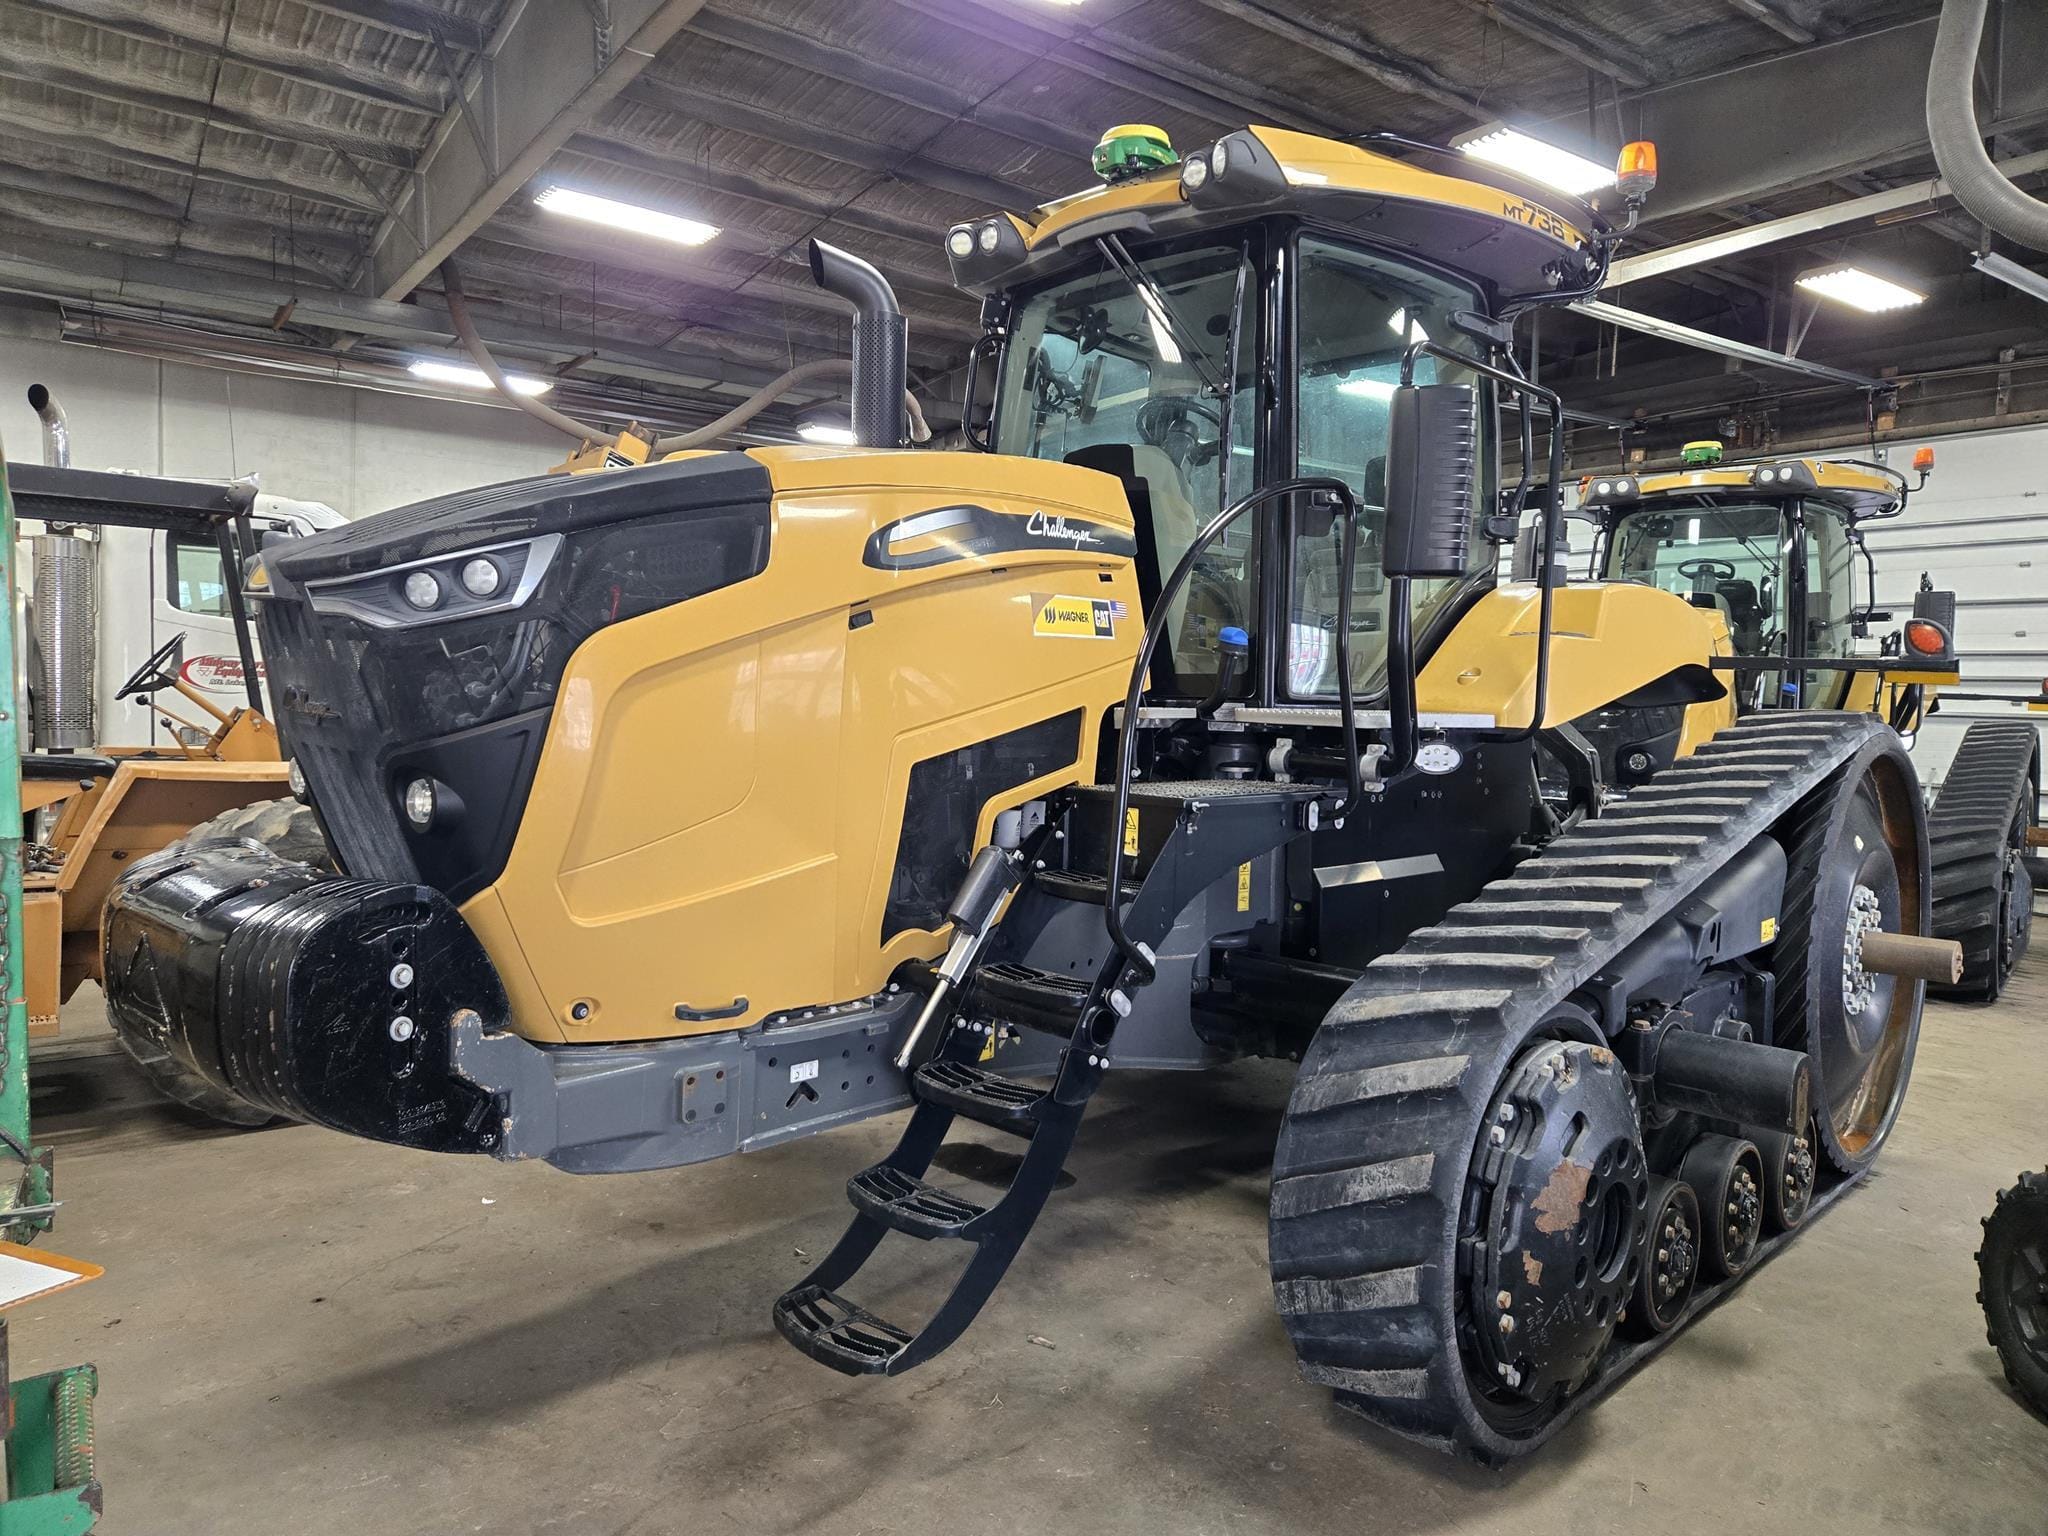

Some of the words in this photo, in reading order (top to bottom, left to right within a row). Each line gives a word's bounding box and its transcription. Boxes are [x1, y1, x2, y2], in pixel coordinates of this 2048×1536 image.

[1815, 462, 1824, 474] 2
[1026, 510, 1104, 550] Challenger
[1058, 610, 1090, 624] WAGNER
[1094, 609, 1110, 628] CAT
